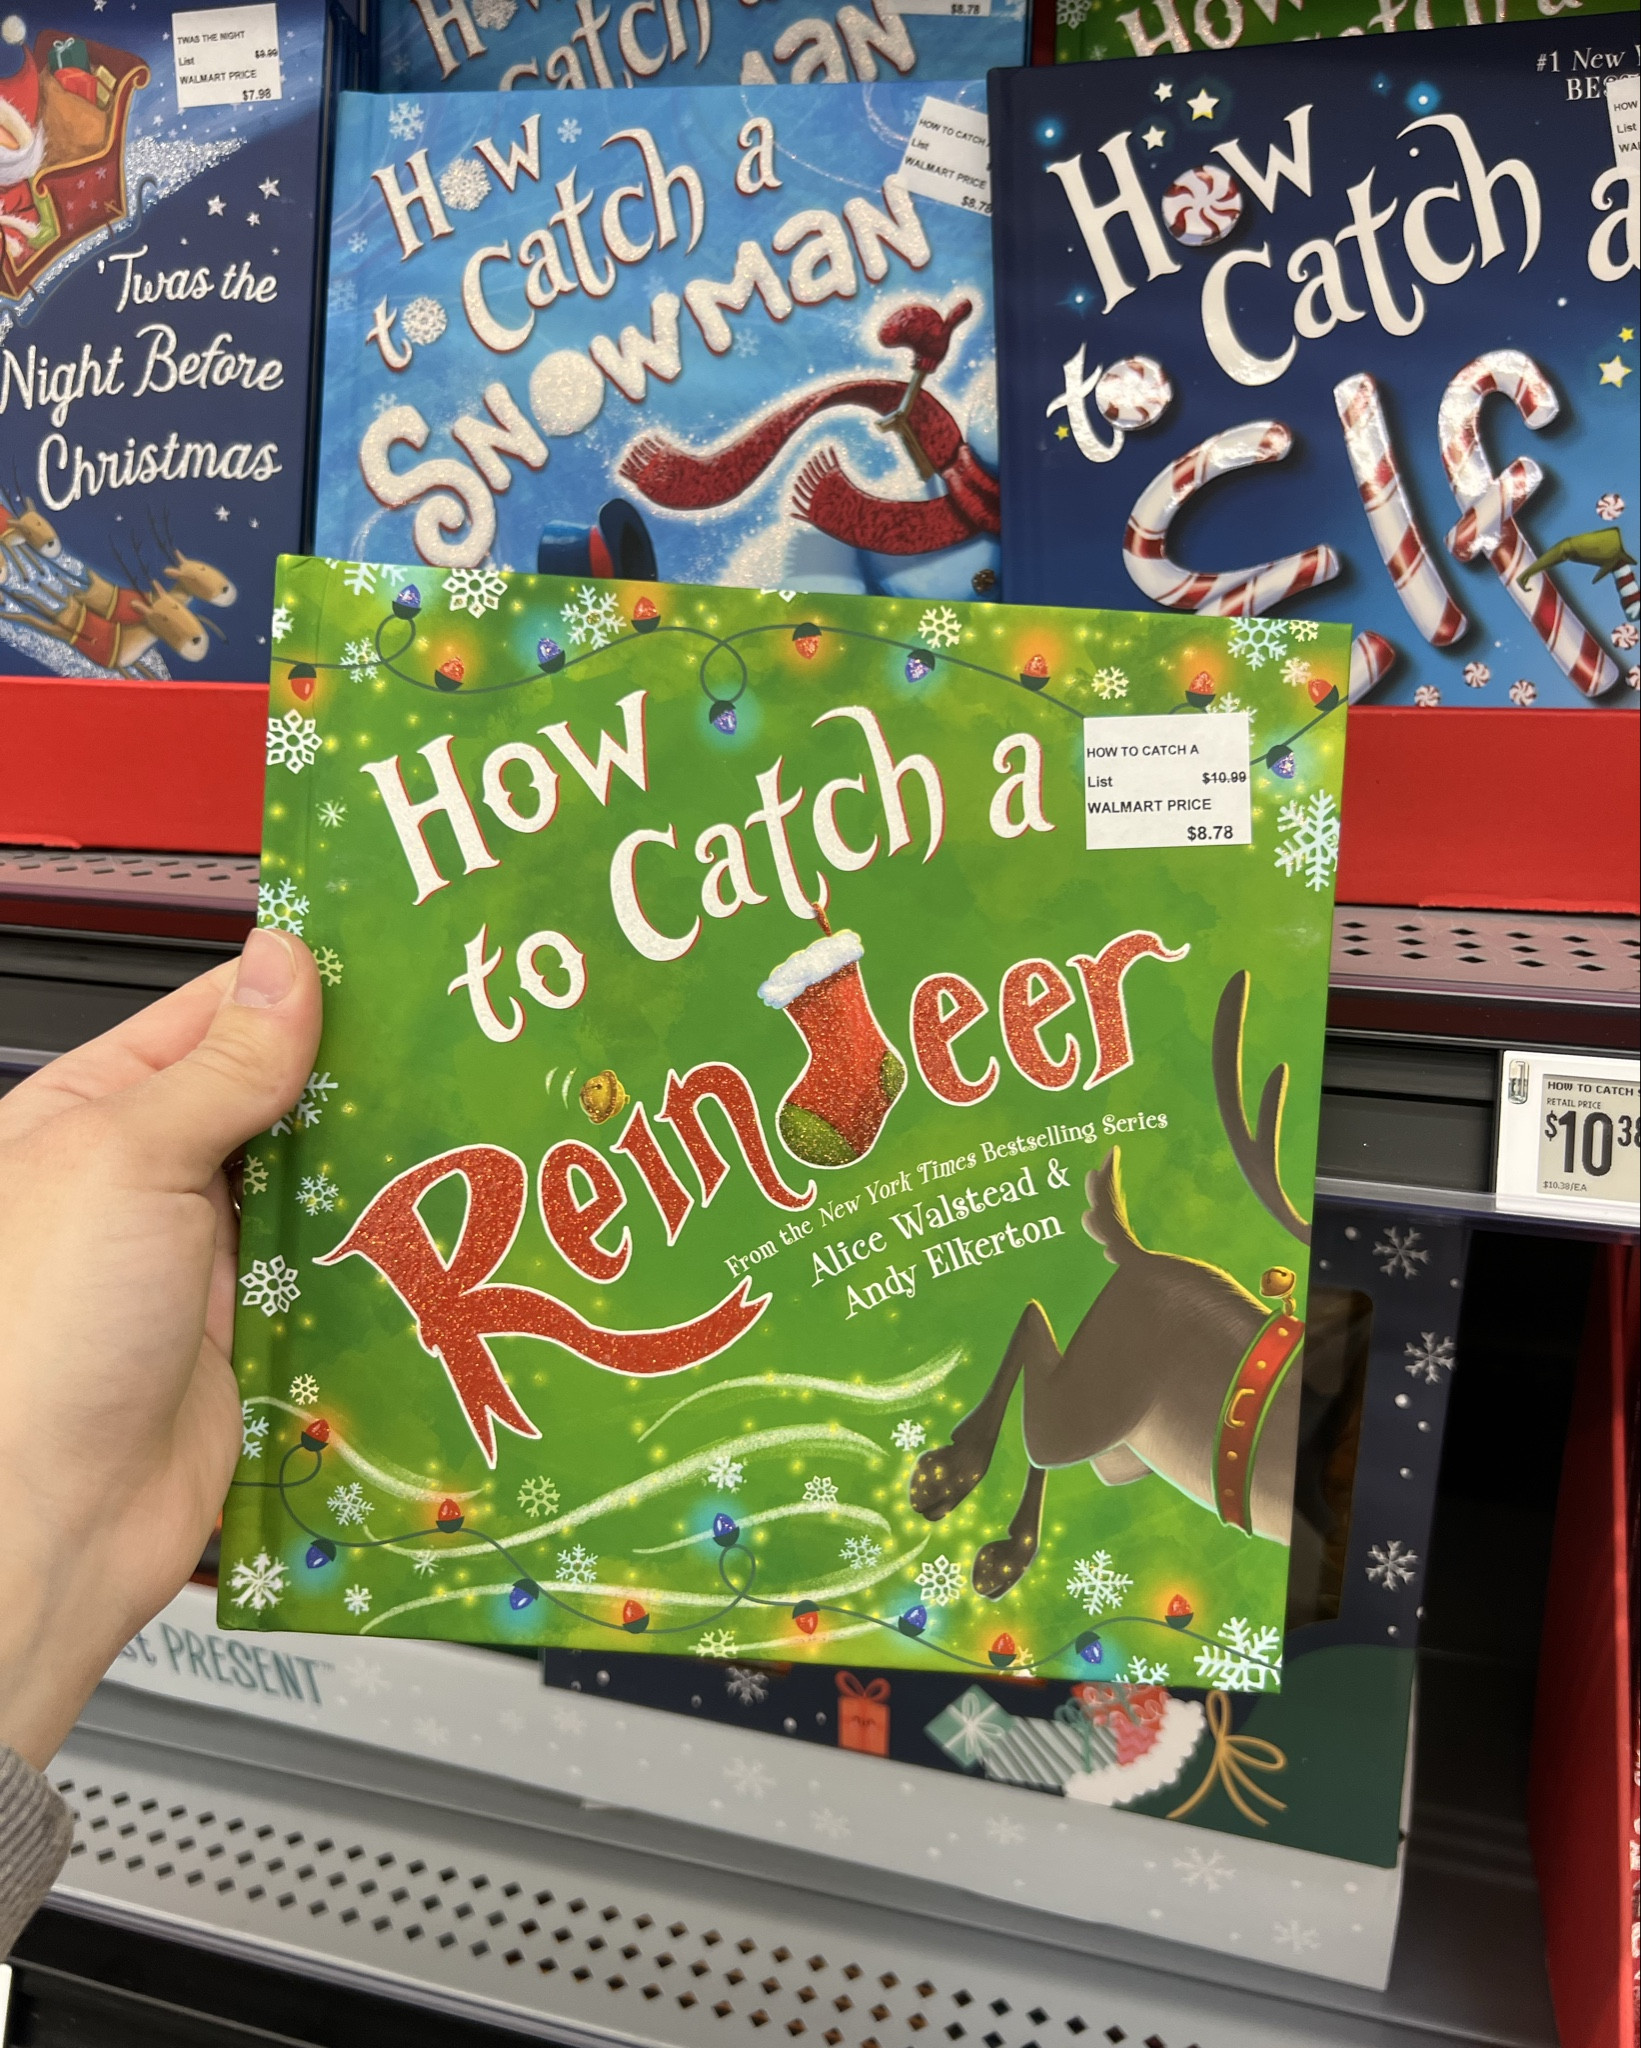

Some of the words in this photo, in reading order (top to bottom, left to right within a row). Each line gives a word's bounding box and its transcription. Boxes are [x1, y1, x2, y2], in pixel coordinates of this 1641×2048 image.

[951, 3, 981, 15] $8.78
[177, 36, 200, 45] TWAS
[202, 33, 218, 43] THE
[220, 31, 245, 41] NIGHT
[178, 57, 195, 67] List
[1536, 50, 1560, 72] #1
[1571, 47, 1626, 71] New
[180, 73, 226, 84] WALMART
[229, 70, 257, 80] PRICE
[242, 88, 271, 101] $7.98
[1614, 100, 1638, 111] HOW
[918, 119, 941, 132] HOW
[942, 126, 954, 136] TO
[955, 131, 986, 147] CATCH
[1617, 123, 1637, 134] List
[912, 138, 929, 151] List
[904, 156, 955, 178] WALMART
[957, 172, 987, 189] PRICE
[371, 113, 543, 262] How
[1046, 105, 1313, 314] How
[366, 295, 447, 371] to
[462, 128, 705, 353] Catch
[736, 116, 784, 195] a
[220, 261, 278, 303] the
[1046, 343, 1172, 463] to
[1202, 114, 1541, 386] Catch
[1587, 166, 1640, 281] a
[0, 344, 125, 428] Night
[133, 323, 284, 397] Before
[38, 432, 283, 511] Christmas
[1087, 746, 1117, 758] HOW
[1121, 746, 1139, 757] TO
[1142, 744, 1187, 756] CATCH
[1190, 744, 1200, 755] A
[1087, 776, 1113, 788] List
[1202, 771, 1247, 784] $10.99
[359, 690, 650, 906] How
[1087, 801, 1163, 813] WALMART
[1167, 798, 1212, 811] PRICE
[1187, 825, 1234, 841] $8.78
[447, 923, 588, 1043] to
[610, 705, 946, 962] Catch
[989, 732, 1057, 839] a
[1547, 1081, 1573, 1091] HOW
[1577, 1083, 1592, 1093] TO
[1596, 1085, 1633, 1097] CATCH
[1546, 1097, 1576, 1108] RETAIL
[1578, 1100, 1601, 1110] PRICE
[724, 1240, 779, 1278] From
[779, 1221, 814, 1246] the
[818, 1195, 861, 1228] New
[864, 1171, 913, 1205] York
[917, 1152, 977, 1185] Times
[980, 1122, 1097, 1164] Bestselling
[1102, 1112, 1168, 1135] Series
[1542, 1181, 1588, 1193] $10.38/EA
[811, 1231, 887, 1287] Alice
[889, 1166, 1039, 1240] Walstead
[1047, 1158, 1071, 1189] &
[845, 1264, 917, 1320] Andy
[922, 1214, 1066, 1279] Elkerton
